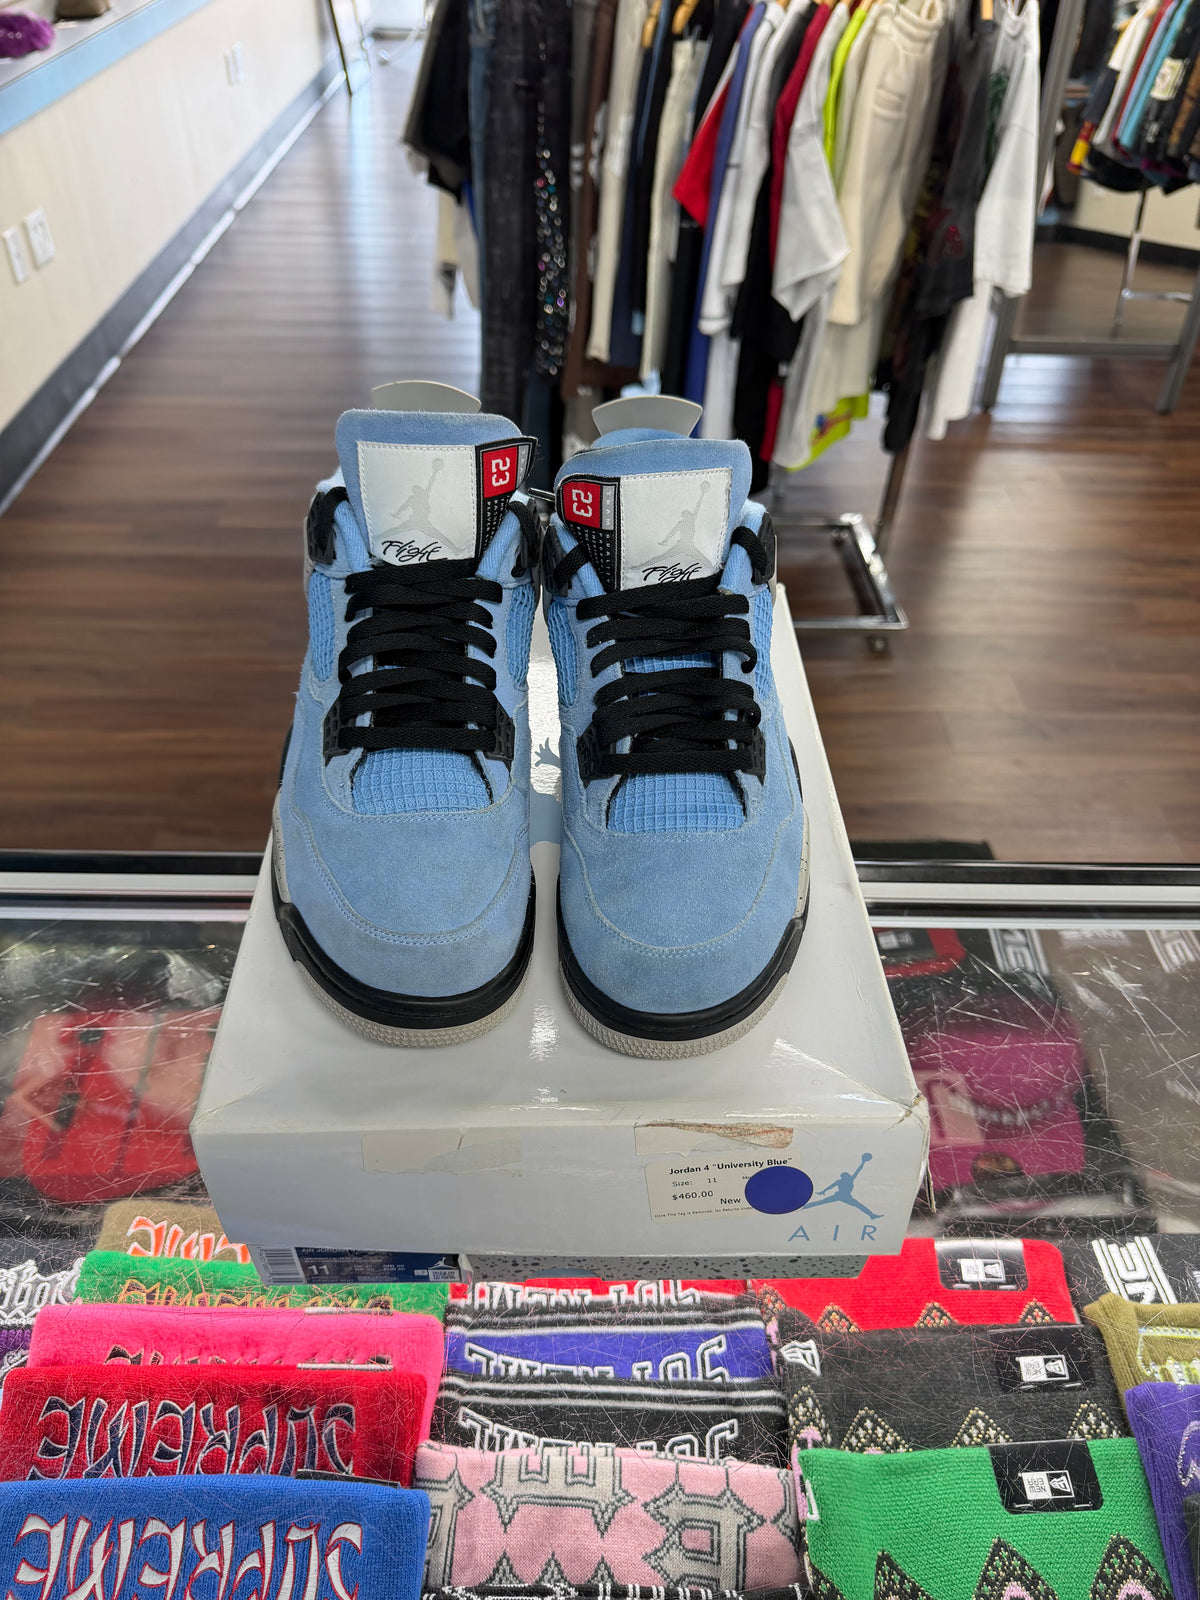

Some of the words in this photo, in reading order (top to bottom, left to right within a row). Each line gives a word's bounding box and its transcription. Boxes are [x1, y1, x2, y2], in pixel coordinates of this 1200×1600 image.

[491, 456, 511, 488] 23
[571, 488, 593, 519] 23
[381, 539, 443, 563] Flight
[641, 562, 703, 584] Flight
[669, 1166, 702, 1176] Jordan
[712, 1160, 765, 1171] "University
[766, 1157, 793, 1167] Blue"
[671, 1179, 693, 1188] Size:
[671, 1190, 714, 1201] $460.00
[720, 1197, 742, 1206] New
[787, 1224, 878, 1242] AIR
[307, 1264, 330, 1275] 11
